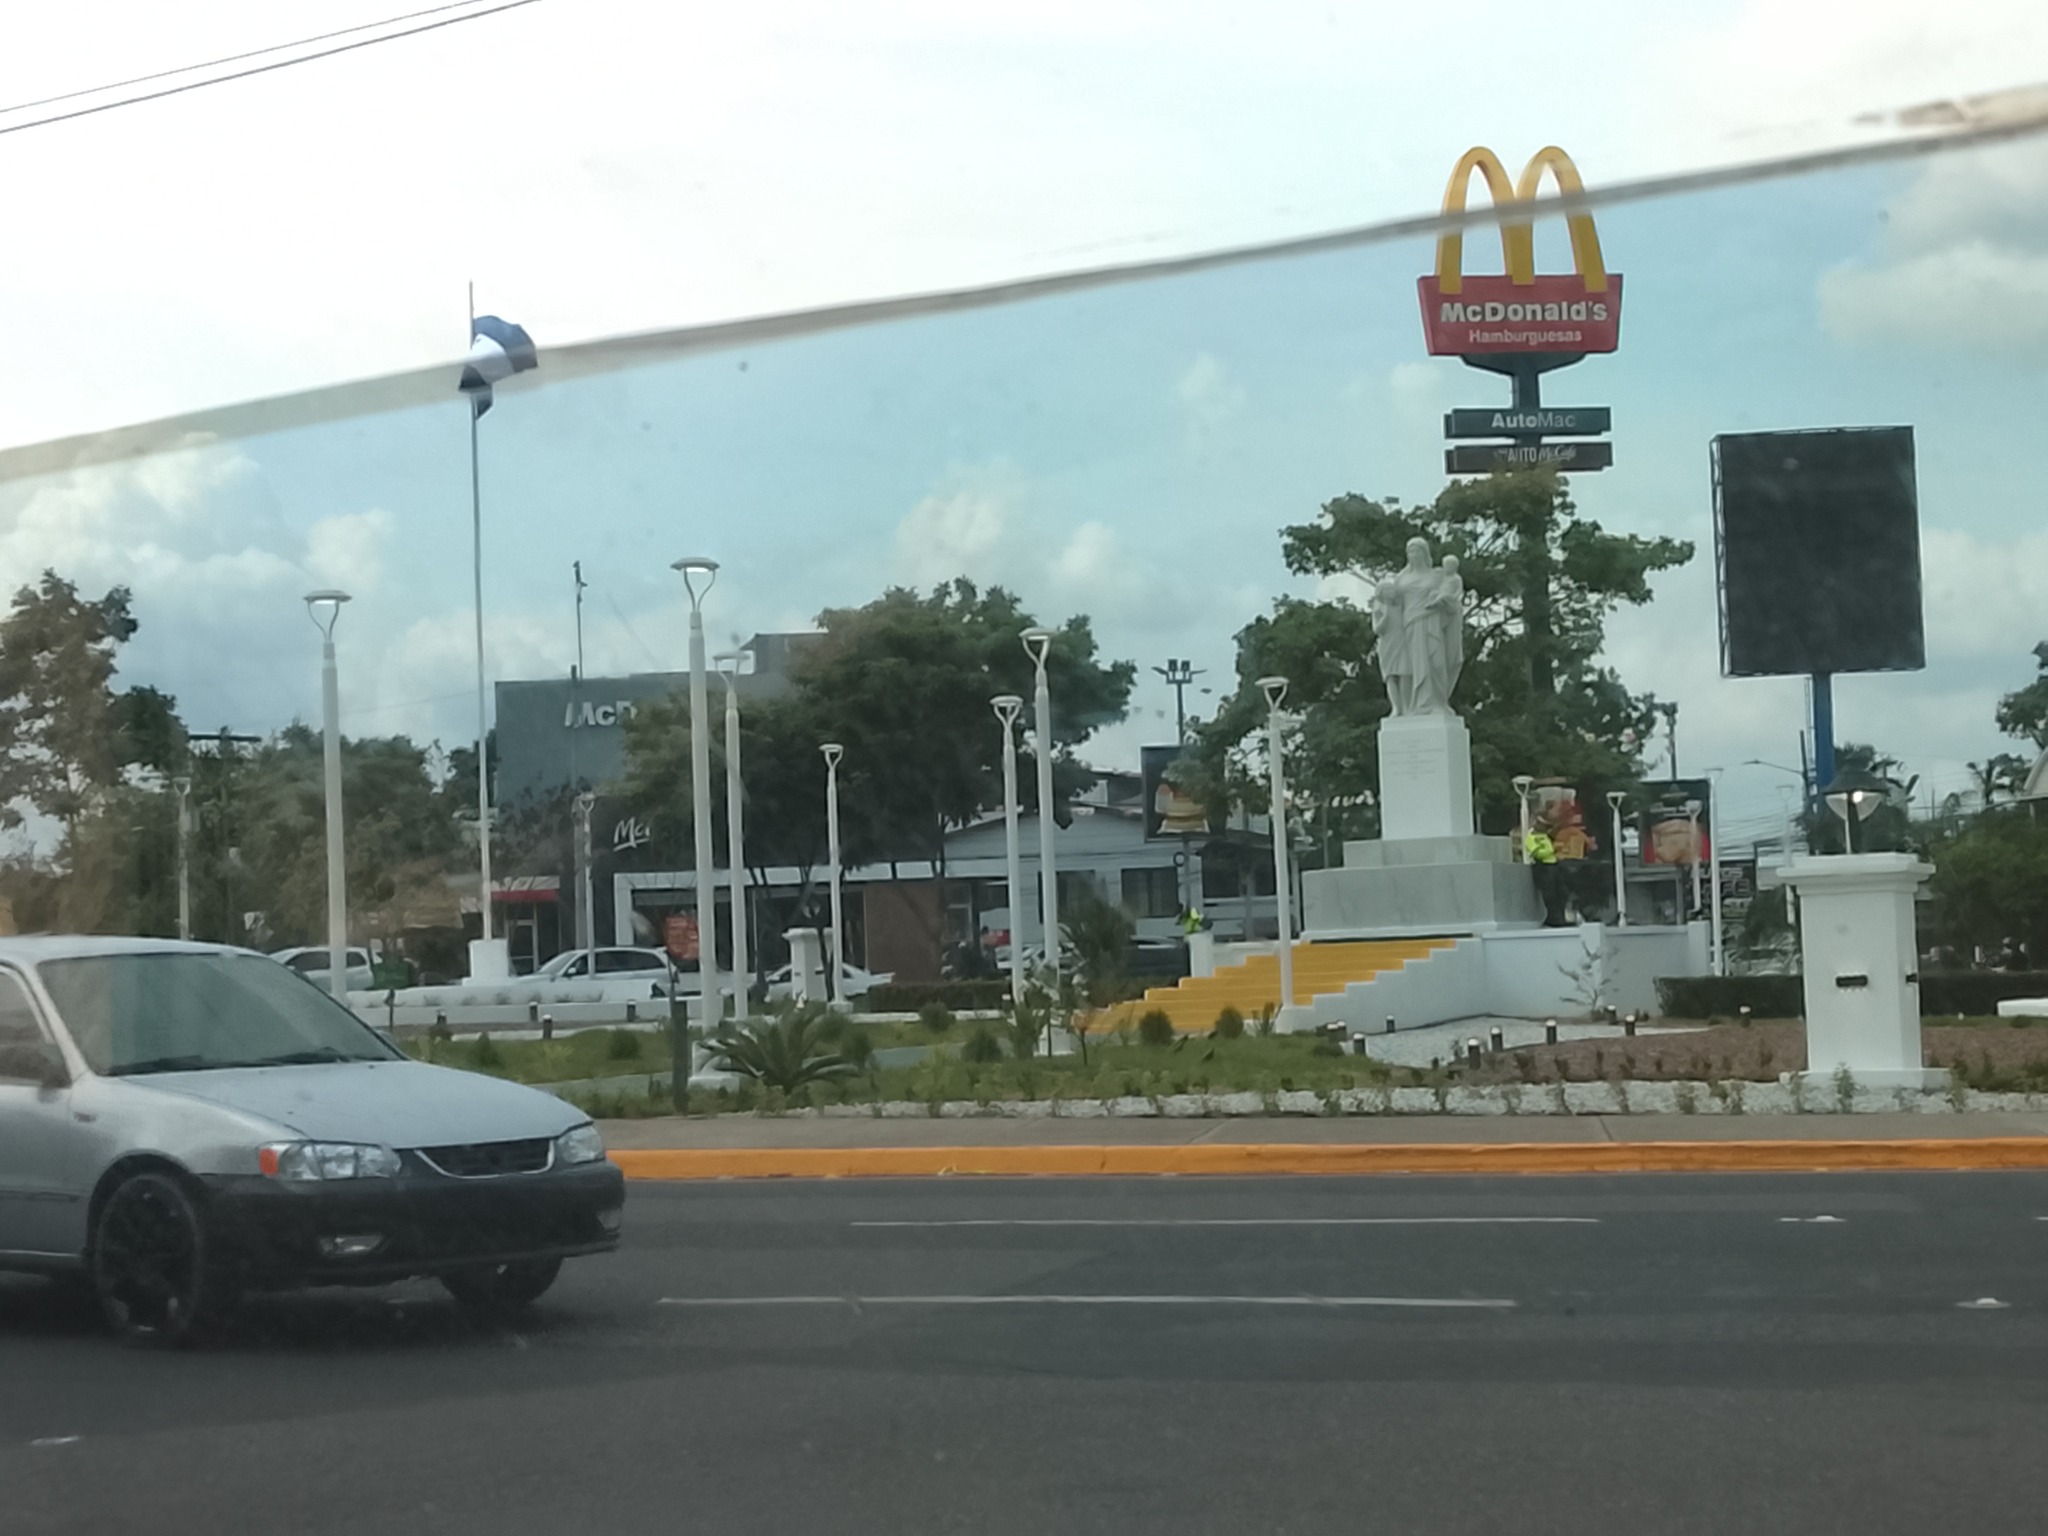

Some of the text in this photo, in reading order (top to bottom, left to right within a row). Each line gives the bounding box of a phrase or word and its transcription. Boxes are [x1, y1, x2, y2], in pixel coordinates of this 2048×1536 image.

[1440, 301, 1608, 322] McDonald's
[1469, 329, 1583, 345] Hamburguesas
[1491, 412, 1577, 428] AutoMac
